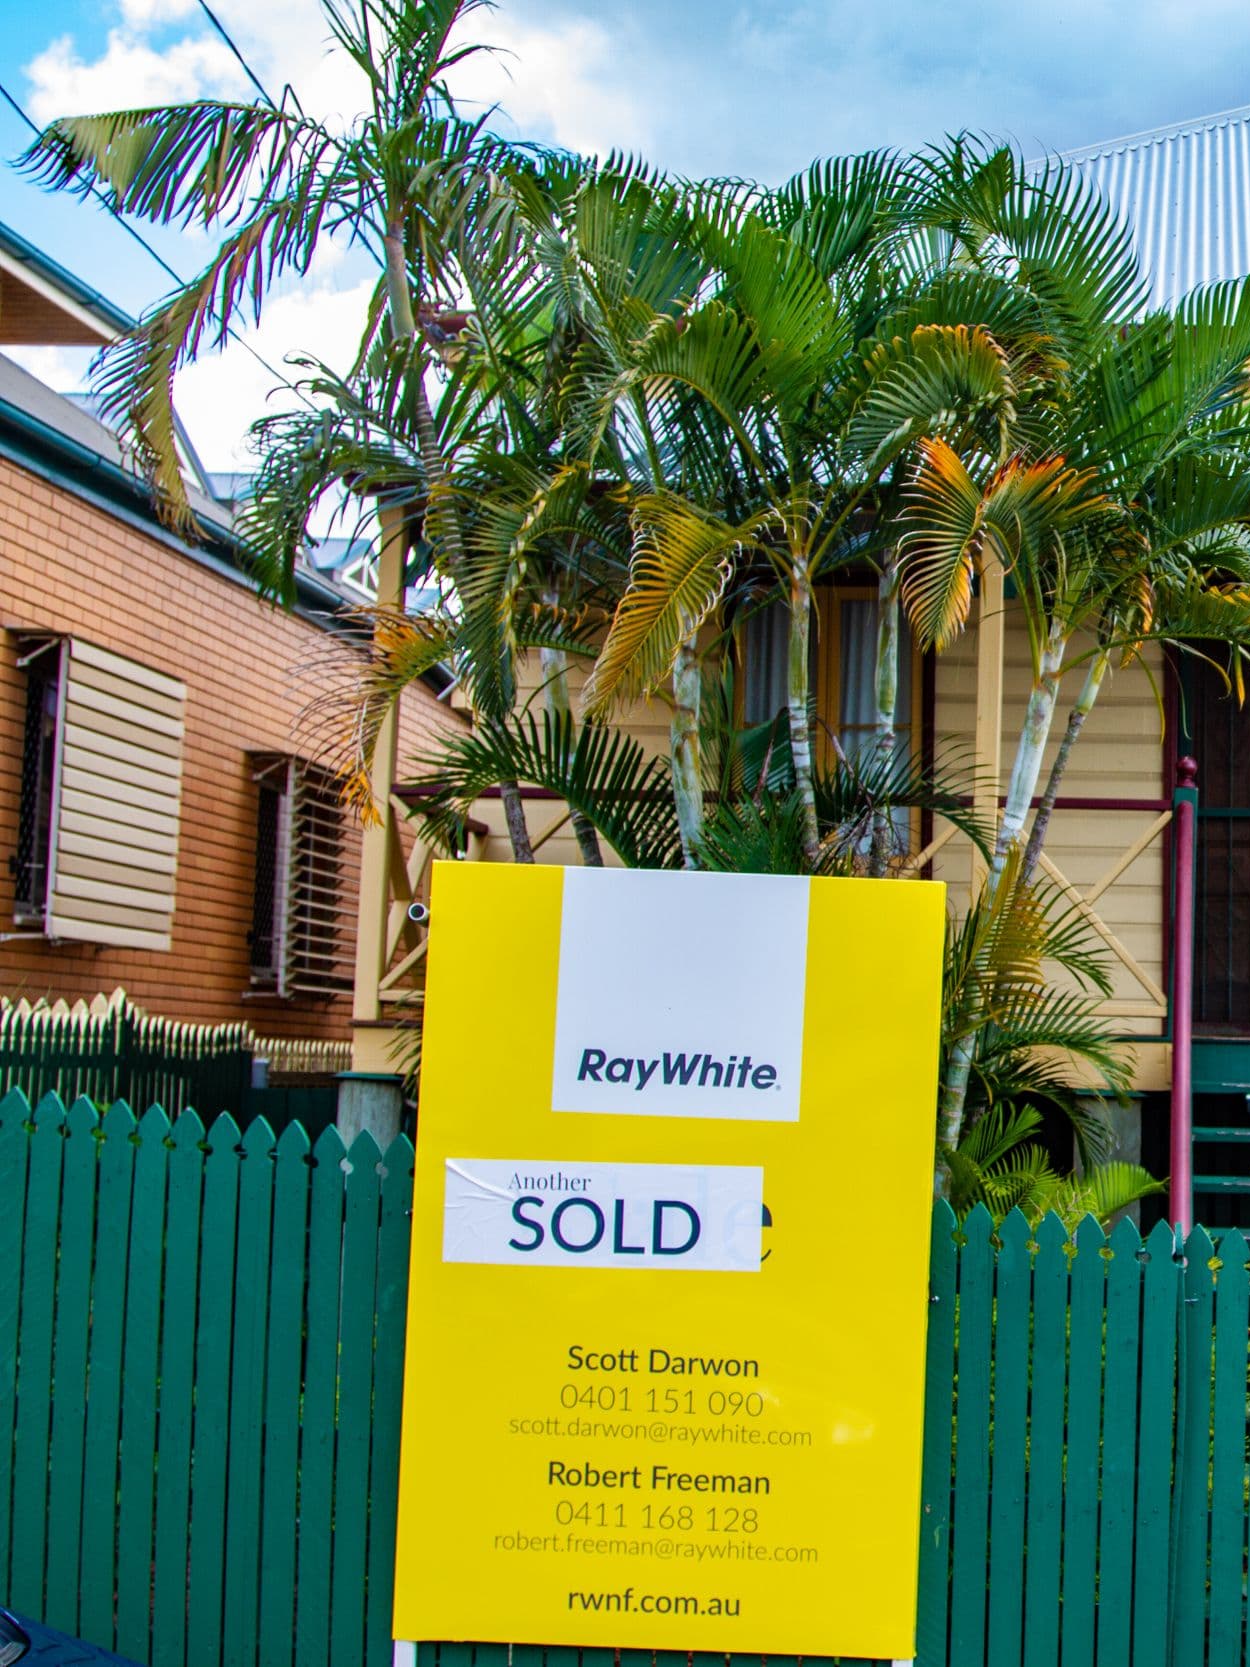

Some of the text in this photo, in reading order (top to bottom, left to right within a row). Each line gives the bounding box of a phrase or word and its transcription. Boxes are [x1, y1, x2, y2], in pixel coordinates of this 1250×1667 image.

[508, 1172, 592, 1193] Another
[508, 1195, 702, 1256] SOLD
[567, 1345, 760, 1378] Scott Darwon
[560, 1383, 765, 1417] 0401 151 090
[508, 1416, 813, 1447] scott.darwon@raywhite.com
[547, 1460, 771, 1495] Robert Freeman
[554, 1500, 760, 1534] 0411 168 128
[493, 1531, 819, 1563] robert.freeman@raywhite.com
[567, 1588, 741, 1617] rwnf.com.au
